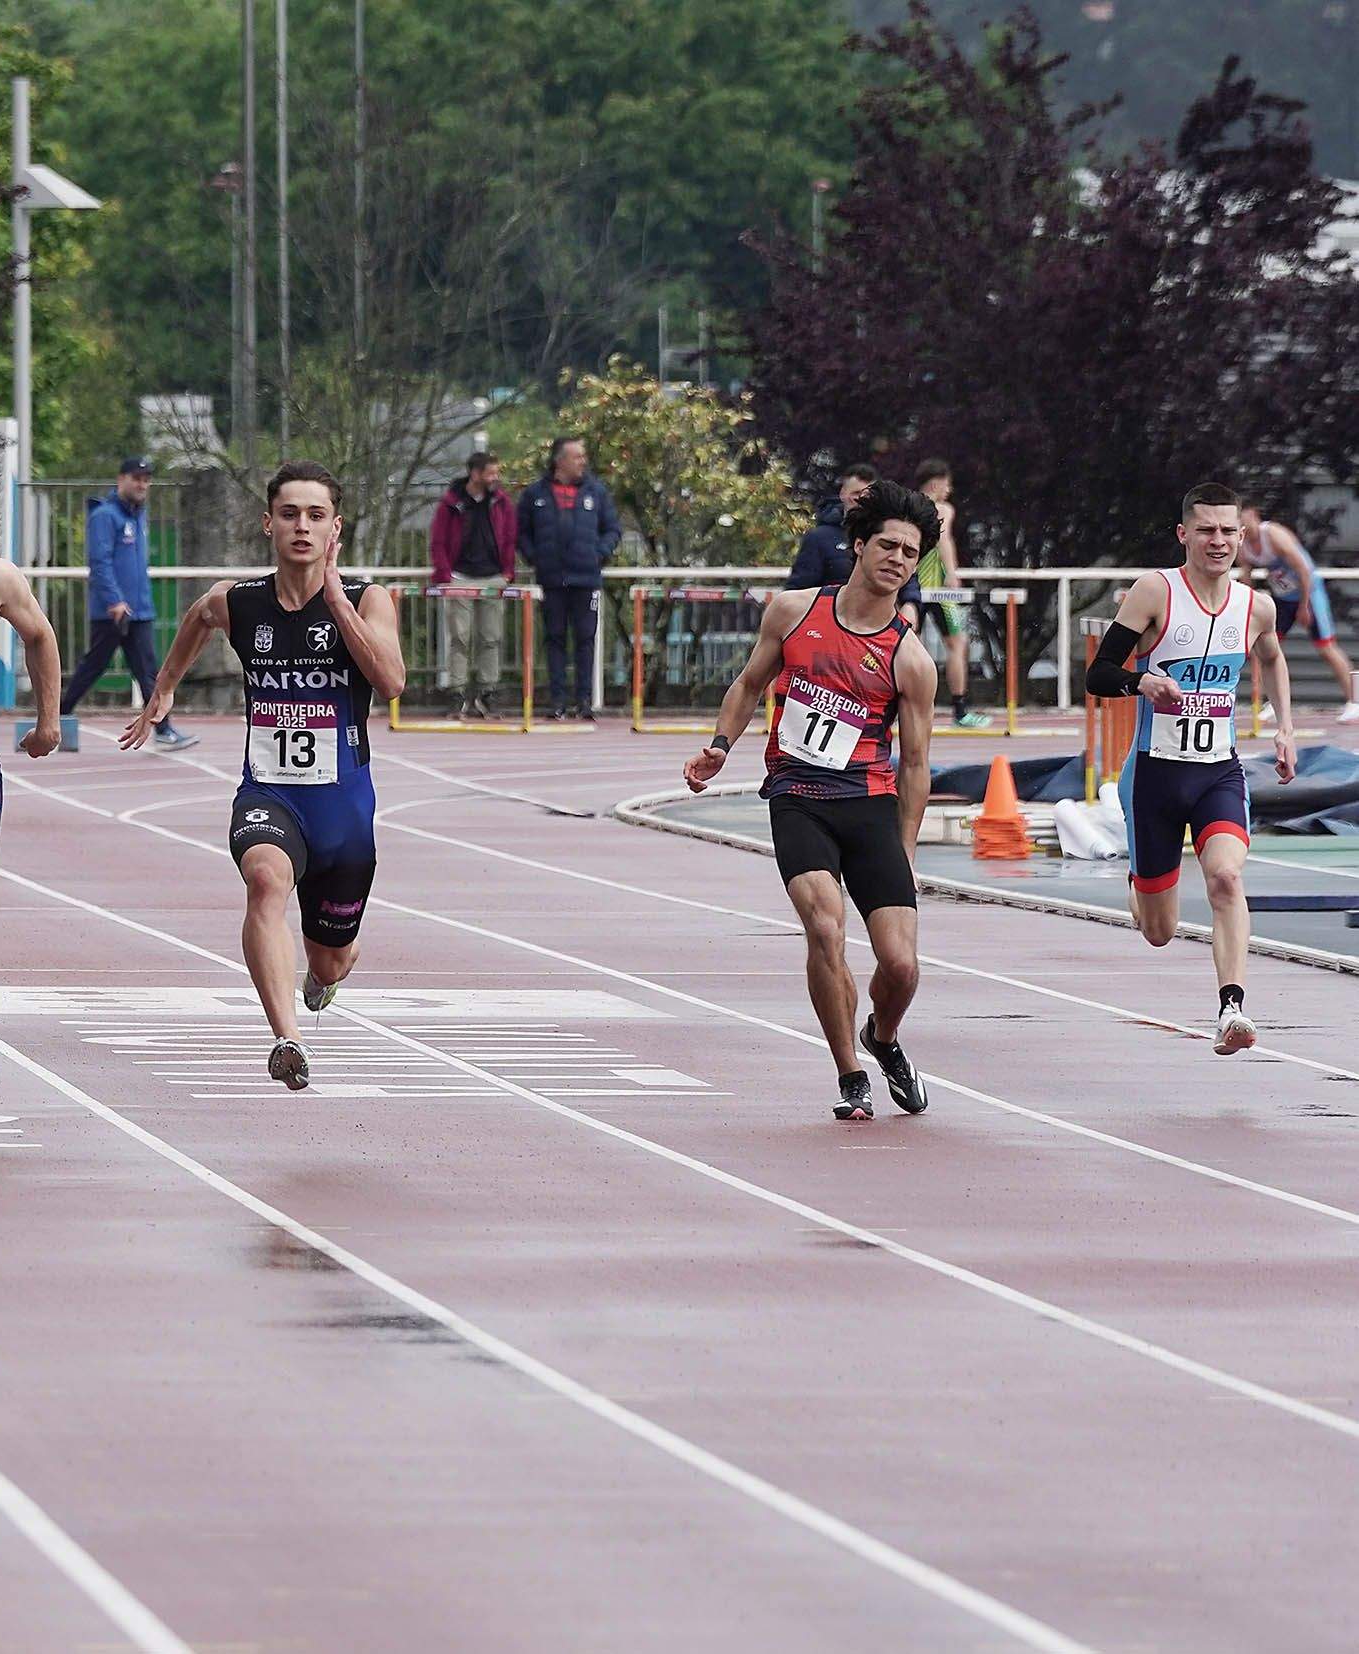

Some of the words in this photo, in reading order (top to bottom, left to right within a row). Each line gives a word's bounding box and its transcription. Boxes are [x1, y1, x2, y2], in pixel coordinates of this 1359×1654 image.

[250, 658, 274, 666] CLUB
[1180, 664, 1230, 683] ADA
[792, 677, 868, 719] PONTEVEDRA
[809, 697, 841, 718] 2025
[1174, 694, 1232, 708] TEVEDRA
[253, 701, 336, 717] PONTEVEDRA
[1180, 705, 1210, 717] 2025
[276, 716, 307, 728] 2025
[803, 711, 838, 753] 11
[1175, 717, 1215, 753] 10
[273, 729, 316, 768] 13
